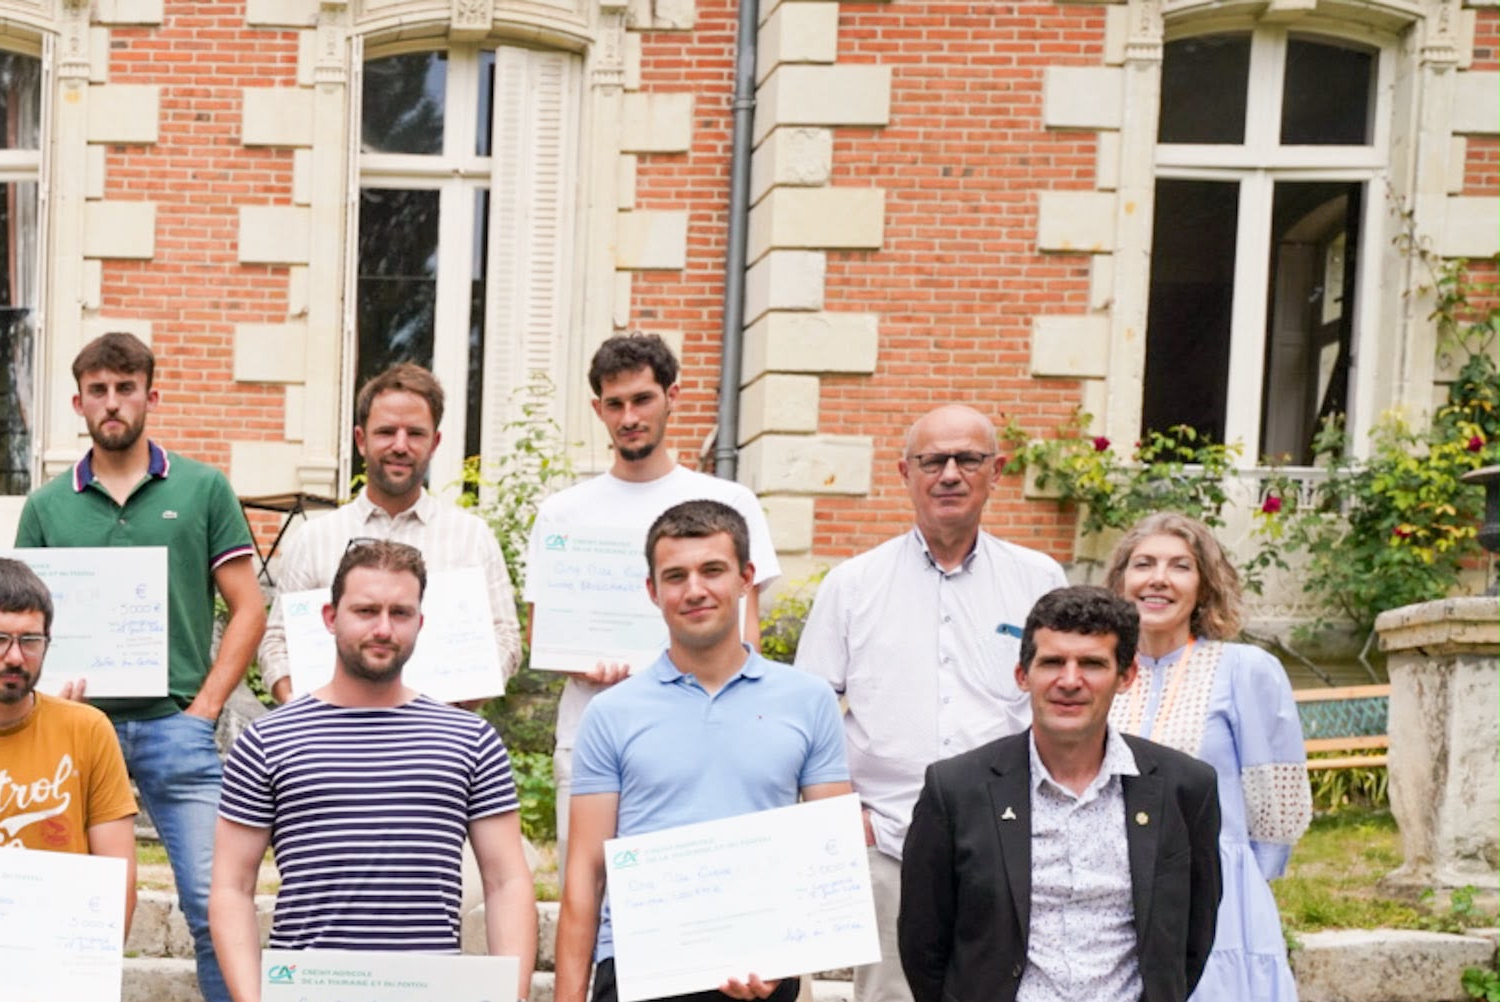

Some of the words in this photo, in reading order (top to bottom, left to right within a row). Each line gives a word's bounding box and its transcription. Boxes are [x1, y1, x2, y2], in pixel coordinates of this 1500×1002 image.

[545, 534, 568, 550] CA
[612, 848, 639, 869] CA
[268, 964, 297, 984] CA
